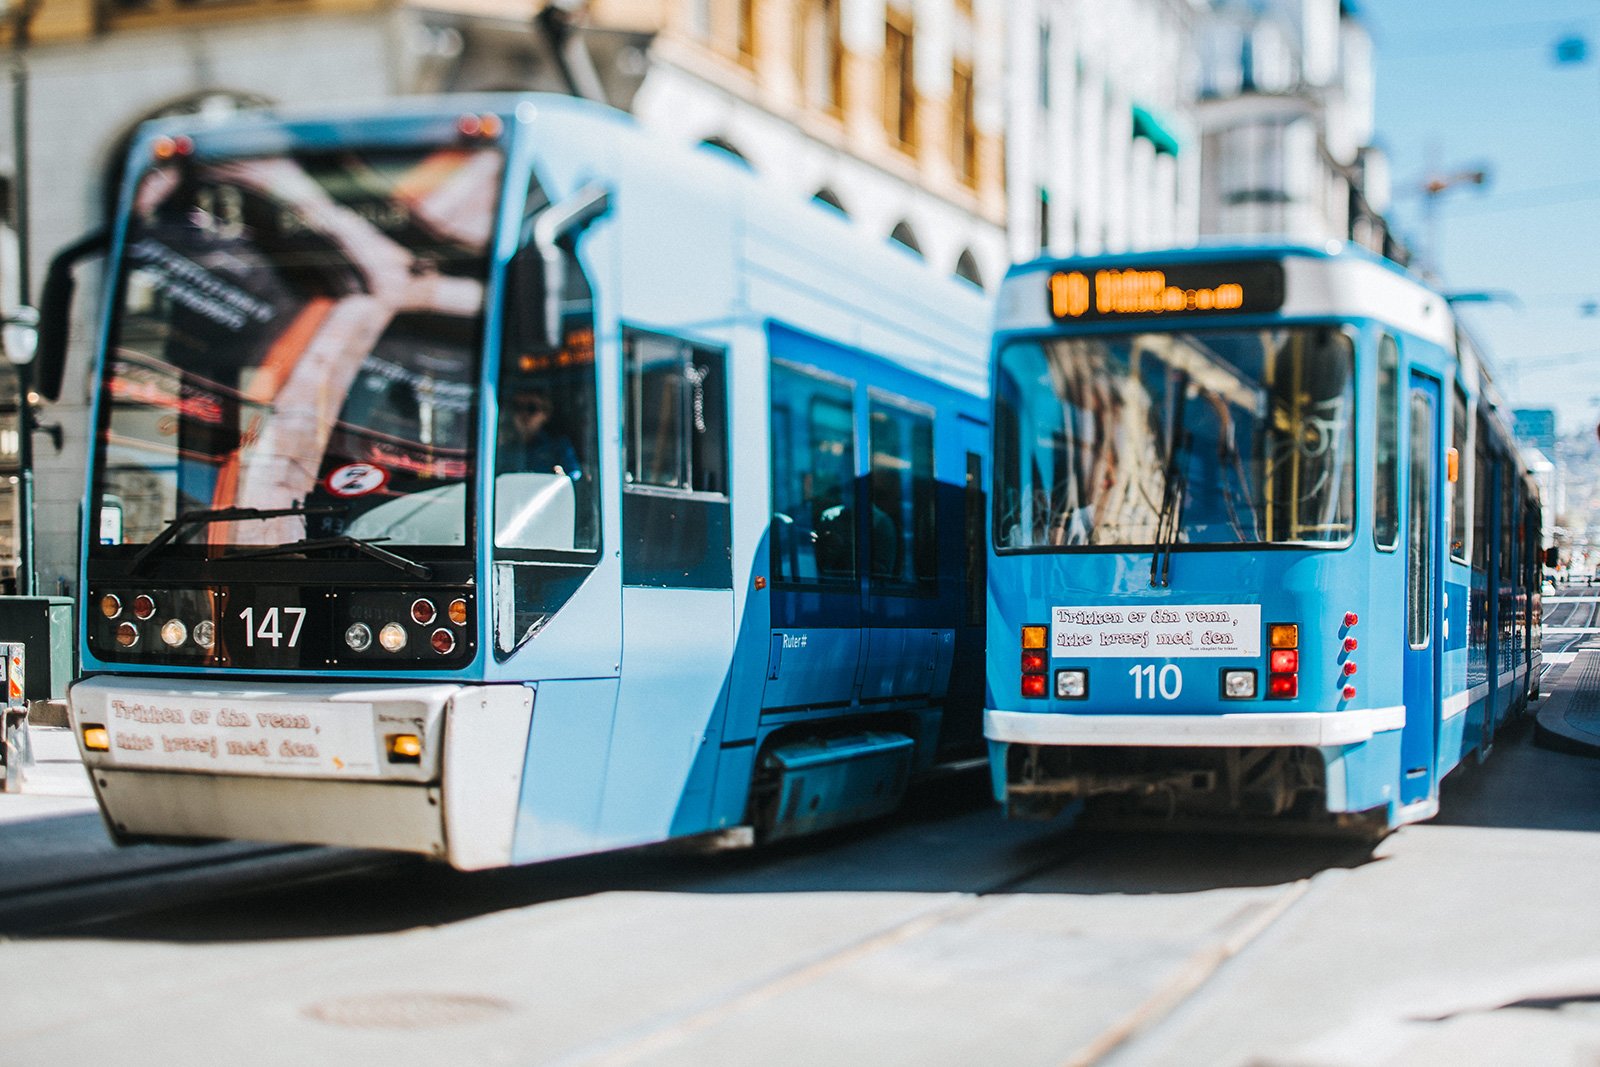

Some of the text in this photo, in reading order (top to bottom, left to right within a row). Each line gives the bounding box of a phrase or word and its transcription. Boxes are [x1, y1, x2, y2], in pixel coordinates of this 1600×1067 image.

[239, 607, 307, 647] 147
[1057, 609, 1123, 625] Trikken
[1127, 612, 1147, 624] er
[1151, 609, 1180, 624] din
[1057, 630, 1234, 648] ikke kræsj med den
[1128, 664, 1183, 700] 110
[112, 700, 185, 724] Trikken
[191, 708, 211, 724] er
[216, 708, 251, 727] din
[116, 732, 154, 750] ikke
[226, 738, 270, 758] med
[279, 738, 320, 758] den
